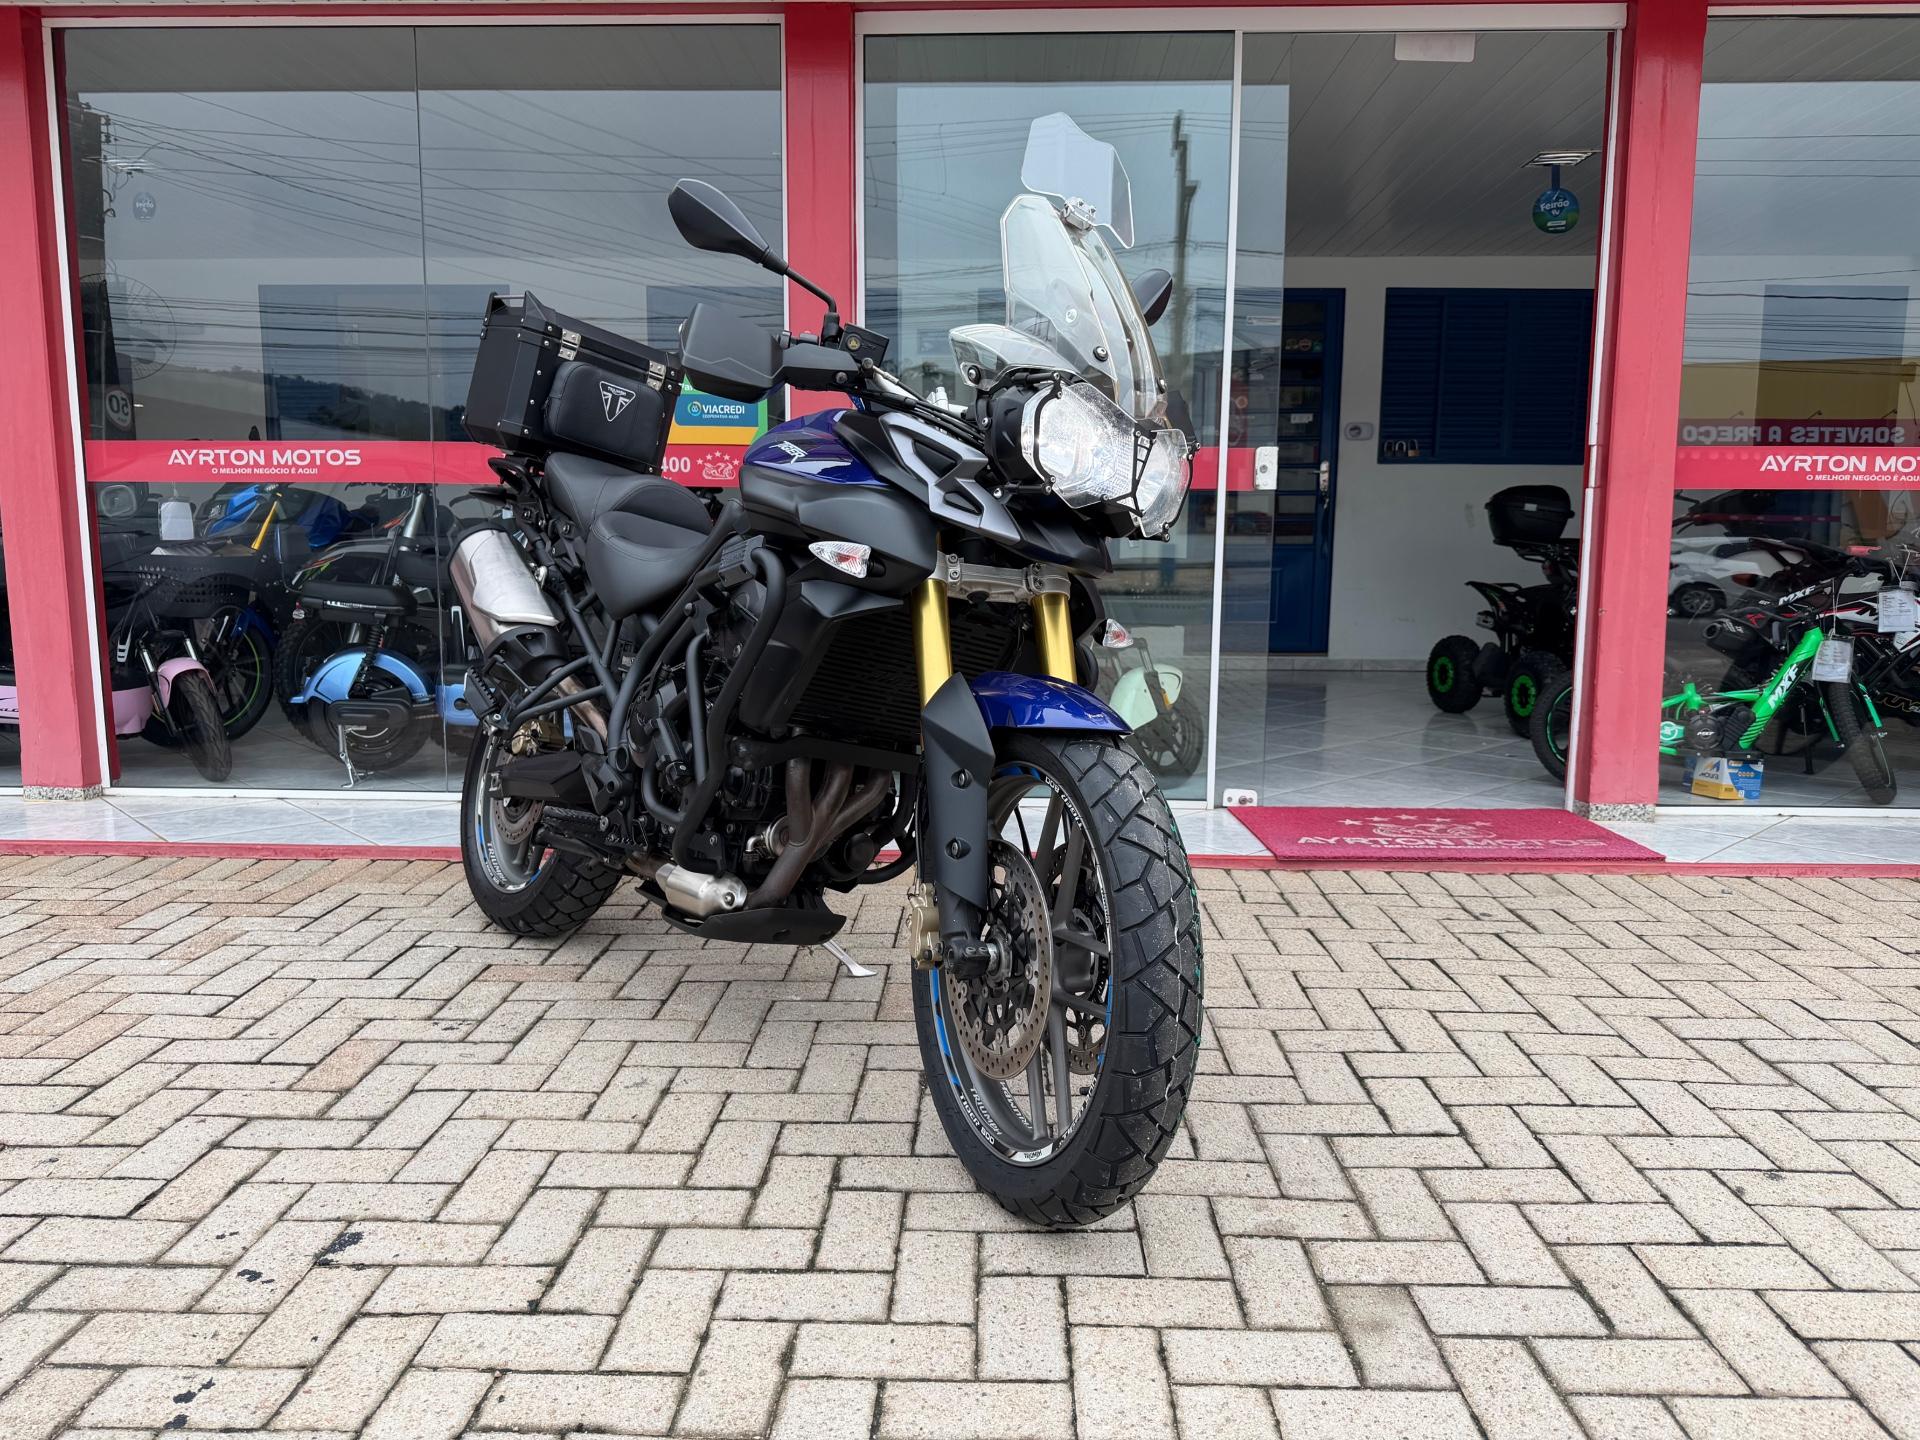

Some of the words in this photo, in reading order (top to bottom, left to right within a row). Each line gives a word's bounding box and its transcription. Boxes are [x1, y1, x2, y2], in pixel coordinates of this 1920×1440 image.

[1540, 199, 1570, 212] Feirão
[702, 404, 745, 415] VIACREDI
[167, 448, 265, 466] AYRTON
[272, 448, 362, 466] MOTOS
[1760, 455, 1867, 472] AYRTON
[1874, 455, 1920, 473] MO
[211, 467, 218, 475] O
[219, 467, 252, 475] MELHOR
[253, 466, 290, 475] NEGÓCIO
[291, 466, 296, 475] É
[297, 467, 318, 475] AQUI
[1852, 473, 1892, 482] NEGÓCIO
[1892, 473, 1899, 482] É
[1778, 585, 1816, 606] MXF
[1767, 663, 1799, 710] MXF
[1298, 836, 1455, 846] AYRTON
[487, 842, 508, 882] TRIUMPH
[970, 1088, 1003, 1135] TRIUMPH
[1000, 1080, 1033, 1129] TRIUMPH
[960, 1092, 980, 1126] TIGER
[981, 1126, 995, 1145] 800
